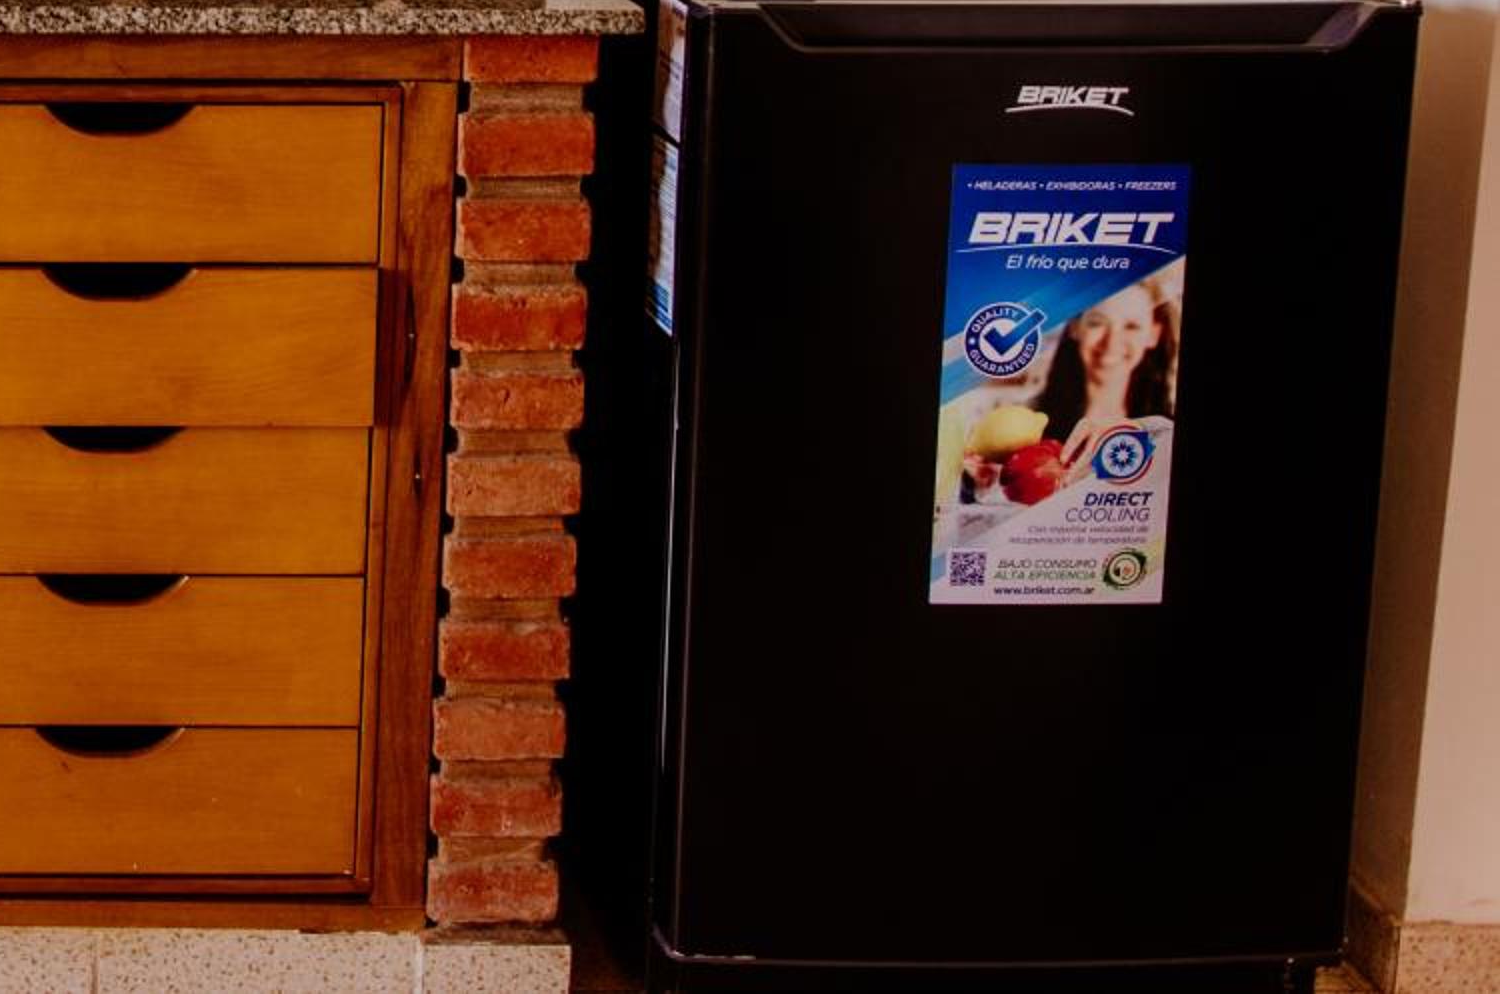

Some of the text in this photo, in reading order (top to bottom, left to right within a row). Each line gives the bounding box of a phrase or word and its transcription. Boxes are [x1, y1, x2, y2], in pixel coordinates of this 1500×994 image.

[1017, 85, 1130, 105] BRIKET
[973, 181, 1177, 190] HELADERAS EXHIBIDORAS FREEZERS
[968, 212, 1175, 244] BRIKET
[1006, 255, 1023, 269] El
[1057, 257, 1089, 272] que
[1092, 255, 1130, 269] dura
[971, 308, 1019, 333] QUALITY
[969, 343, 1034, 373] GUARANTEED
[1084, 492, 1154, 506] DIRECT
[1065, 508, 1150, 522] COOLING
[997, 559, 1097, 568] BAJO CONSUMO
[993, 570, 1096, 580] ALTA EFICIENCIA
[994, 586, 1095, 595] www.briket.com.ar
